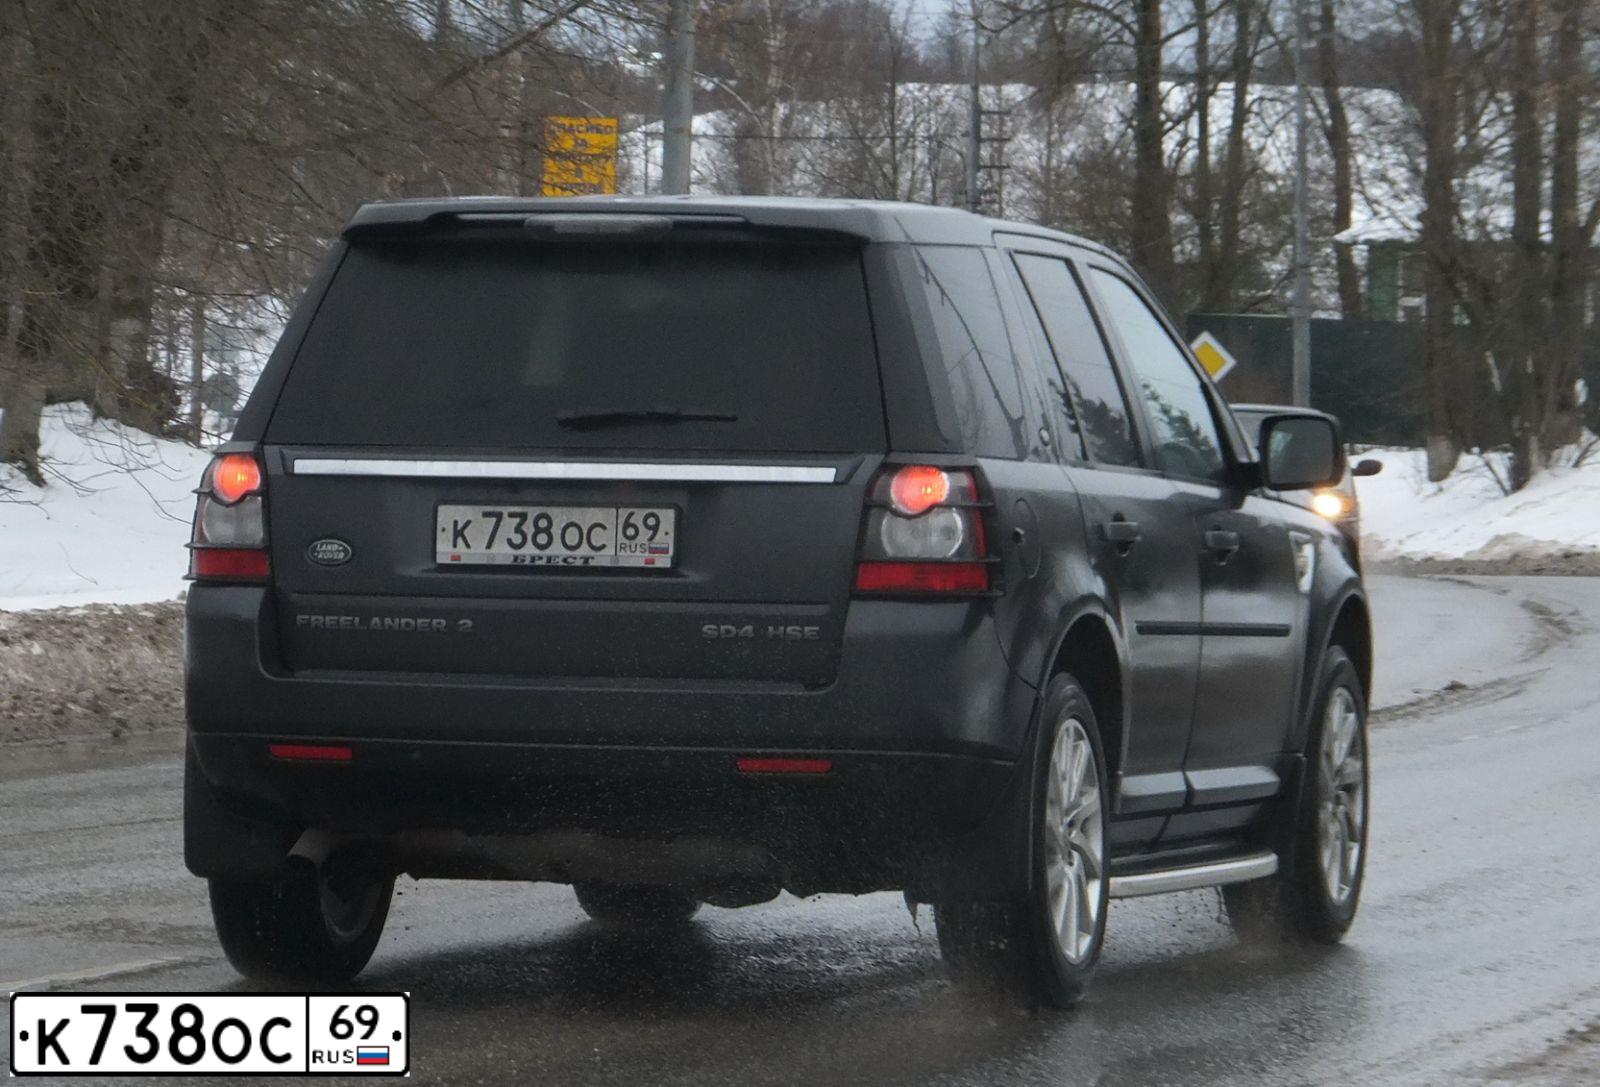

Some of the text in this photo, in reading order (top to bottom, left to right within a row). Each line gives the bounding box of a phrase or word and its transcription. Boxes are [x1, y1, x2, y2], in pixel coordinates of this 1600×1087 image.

[621, 511, 661, 542] 69
[619, 542, 648, 554] RUS
[511, 554, 596, 565] БРЕСТ
[296, 614, 474, 633] FREELANDER 2
[702, 624, 820, 640] SD4 HSE
